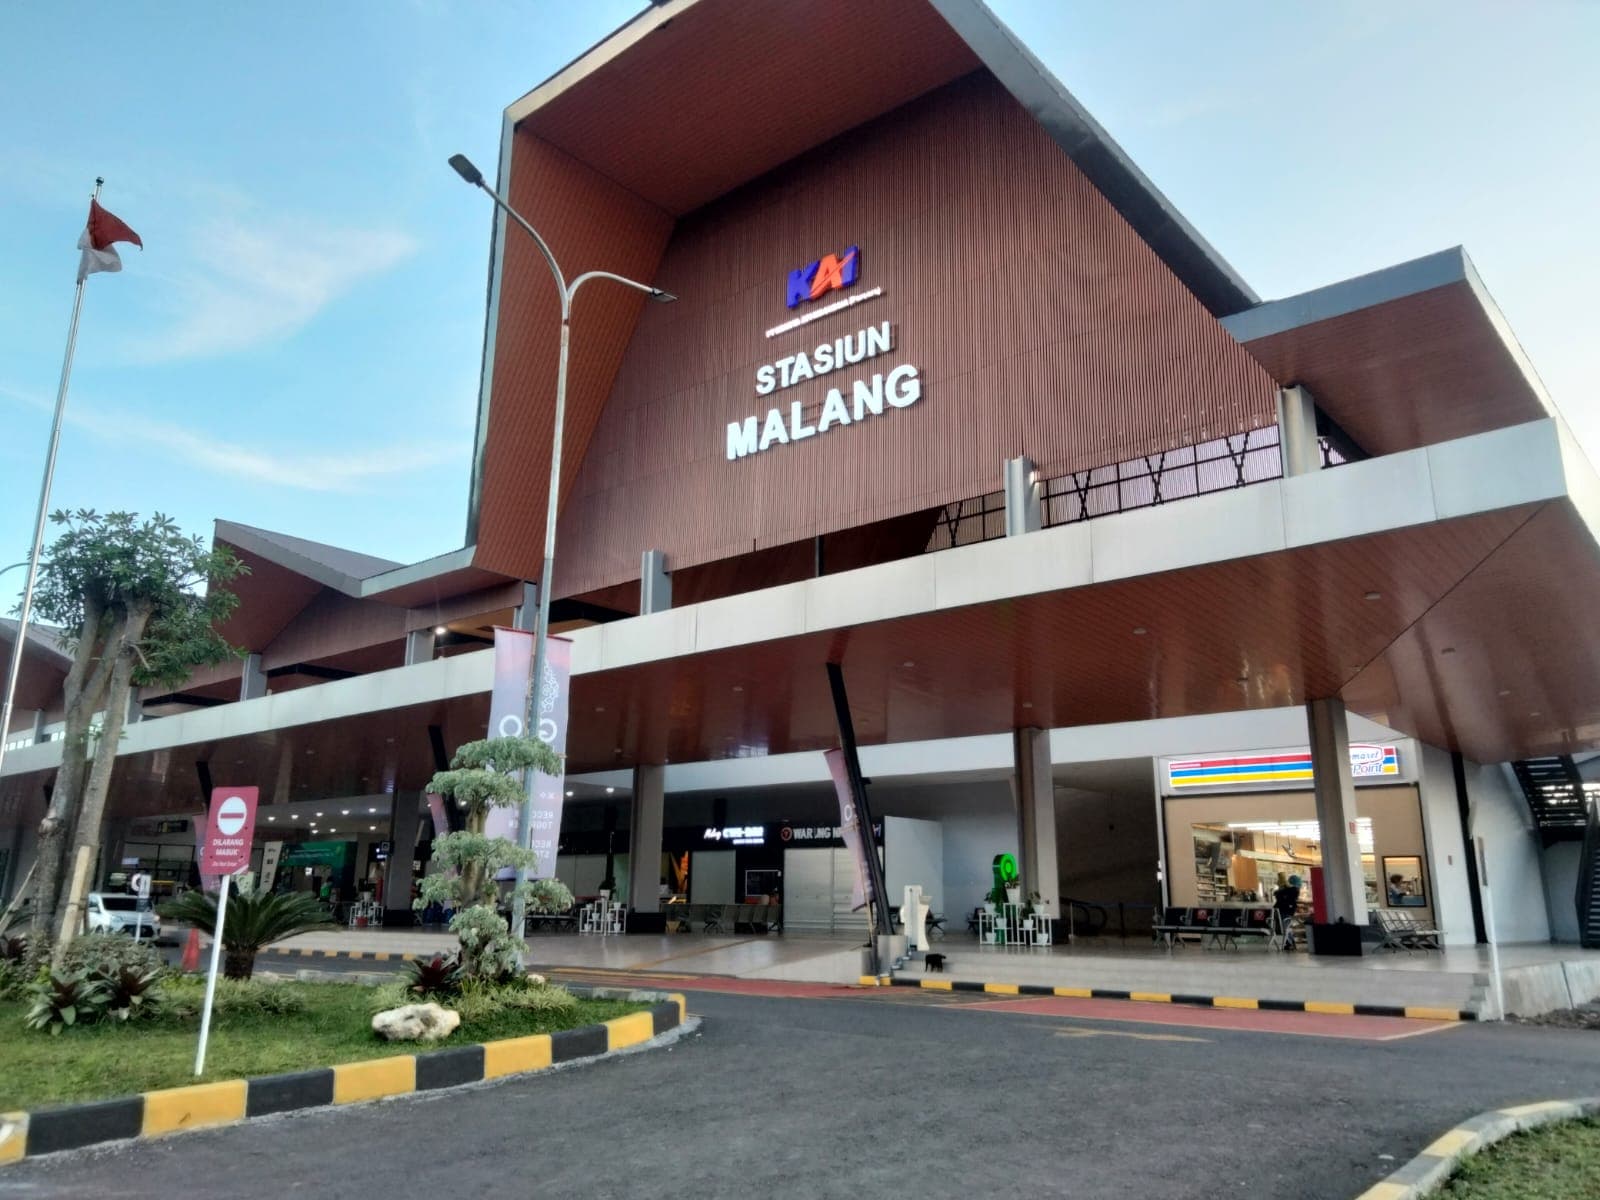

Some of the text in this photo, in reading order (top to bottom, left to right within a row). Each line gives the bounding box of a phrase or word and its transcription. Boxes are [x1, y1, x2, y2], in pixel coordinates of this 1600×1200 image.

[787, 245, 859, 309] KAI
[756, 321, 890, 394] STASIUN
[727, 365, 920, 460] MALANG
[212, 838, 244, 846] DILARANG
